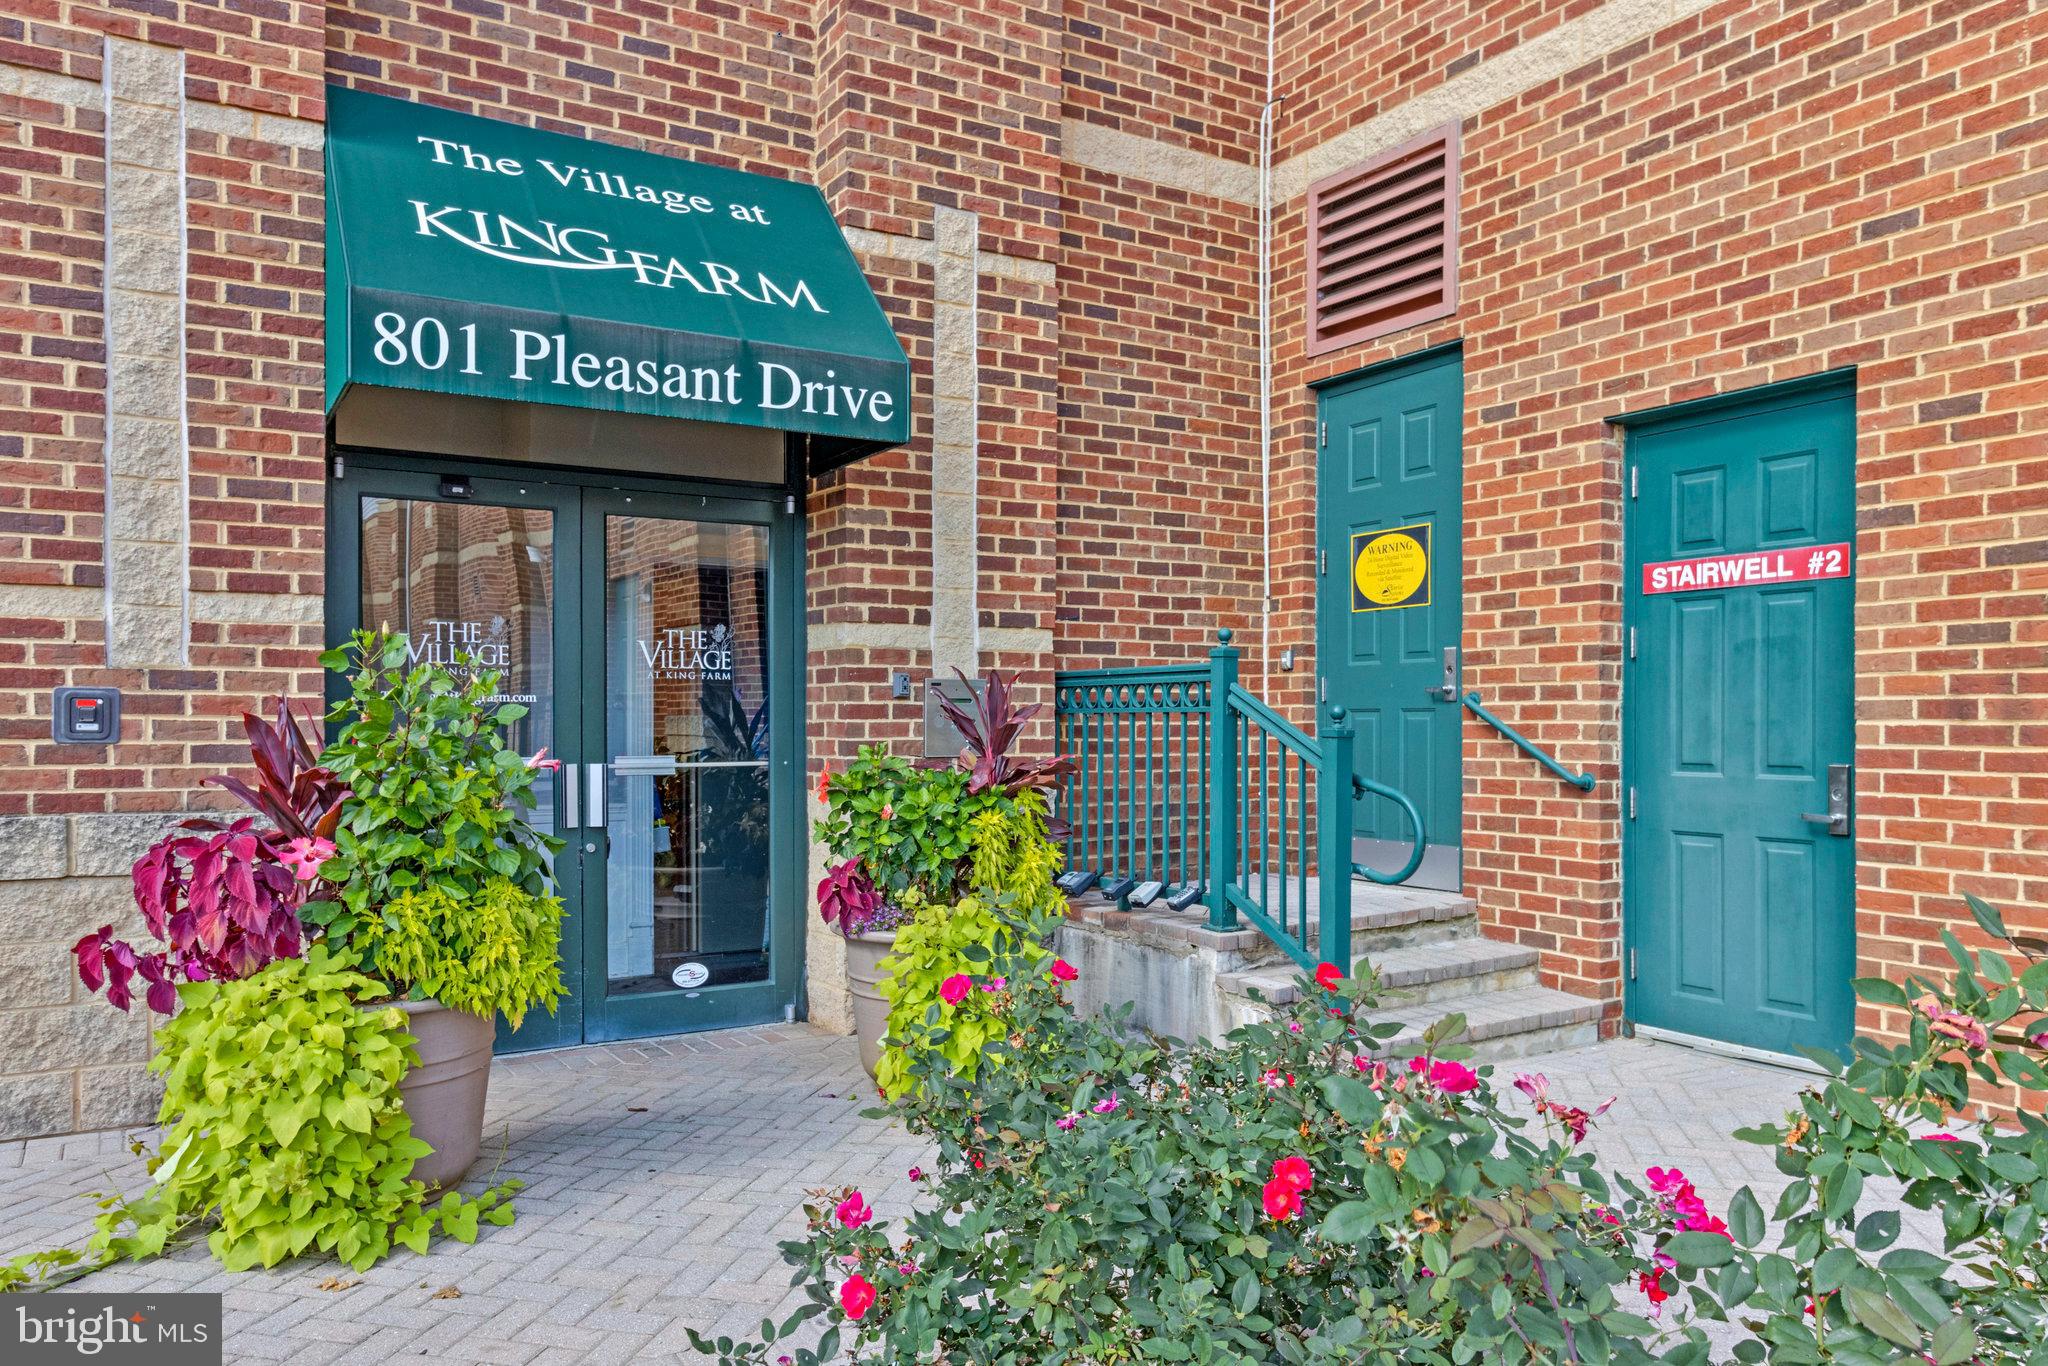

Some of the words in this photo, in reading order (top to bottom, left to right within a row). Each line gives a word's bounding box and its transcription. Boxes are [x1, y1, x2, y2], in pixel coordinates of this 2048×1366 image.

[417, 135, 525, 176] The
[536, 159, 715, 214] Village
[729, 201, 771, 226] at
[373, 312, 483, 376] 801
[509, 328, 742, 405] Pleasant
[757, 361, 895, 423] Drive
[1367, 541, 1413, 555] WARNING
[1652, 555, 1793, 589] STAIRWELL
[1808, 550, 1842, 575] #2
[429, 621, 482, 644] THE
[662, 629, 708, 650] THE
[637, 640, 732, 670] VILLAGE
[647, 671, 660, 679] AT
[666, 671, 696, 680] KING
[701, 671, 731, 681] FARM
